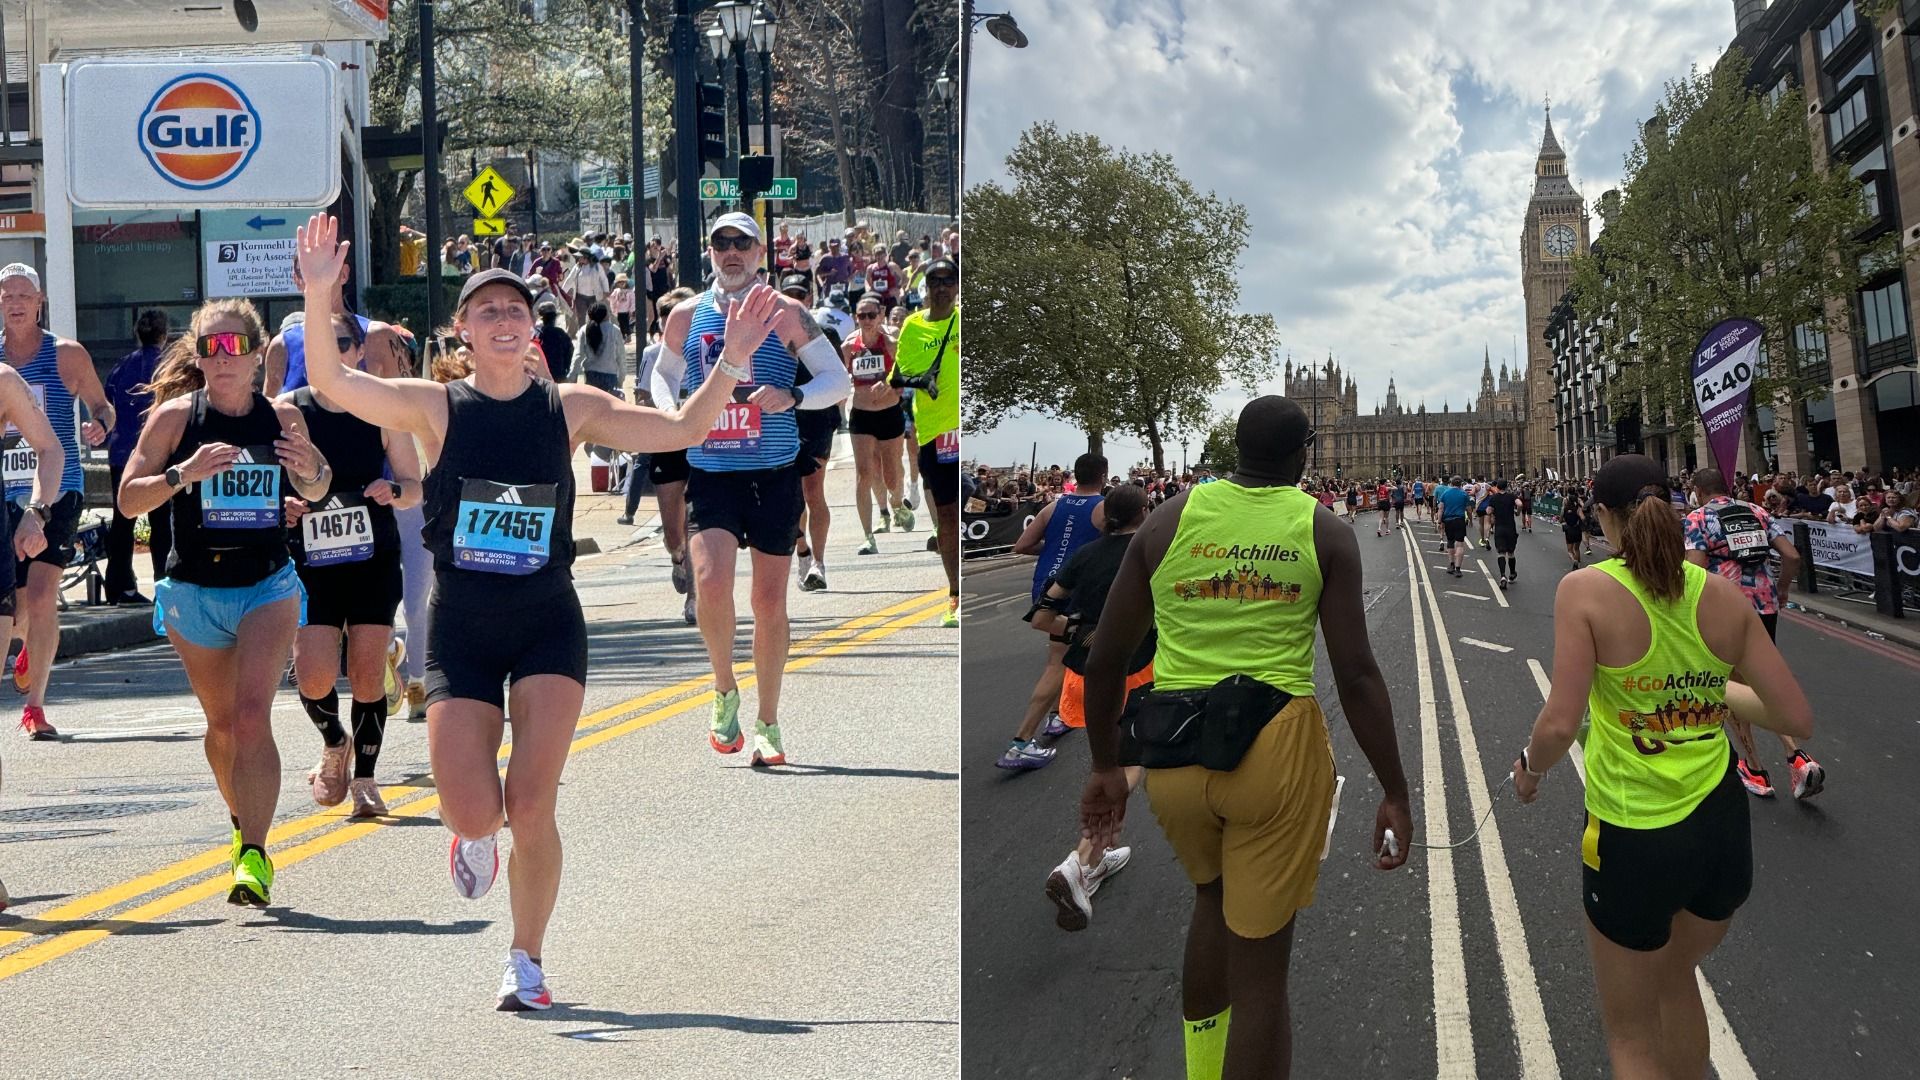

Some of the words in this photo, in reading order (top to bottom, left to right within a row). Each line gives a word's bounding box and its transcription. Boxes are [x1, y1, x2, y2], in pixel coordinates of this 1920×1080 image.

[147, 114, 249, 148] Gulf
[592, 188, 621, 198] Crescent
[94, 241, 133, 255] physical
[137, 241, 172, 254] therapy
[1701, 362, 1751, 403] 4:40
[1706, 403, 1743, 428] INSPIRING
[1710, 412, 1742, 434] ACTIVITY
[212, 469, 274, 497] 16820
[309, 510, 366, 540] 14673
[468, 508, 545, 542] 17455
[457, 536, 464, 545] 2
[1733, 536, 1753, 545] RED
[1809, 538, 1858, 553] ONSULTANCY
[474, 557, 517, 566] MARATHON
[489, 551, 516, 560] BOSTON
[1190, 543, 1299, 562] #GoAchilles
[1812, 549, 1841, 561] ERVICES
[1623, 670, 1725, 693] #GoAchilles
